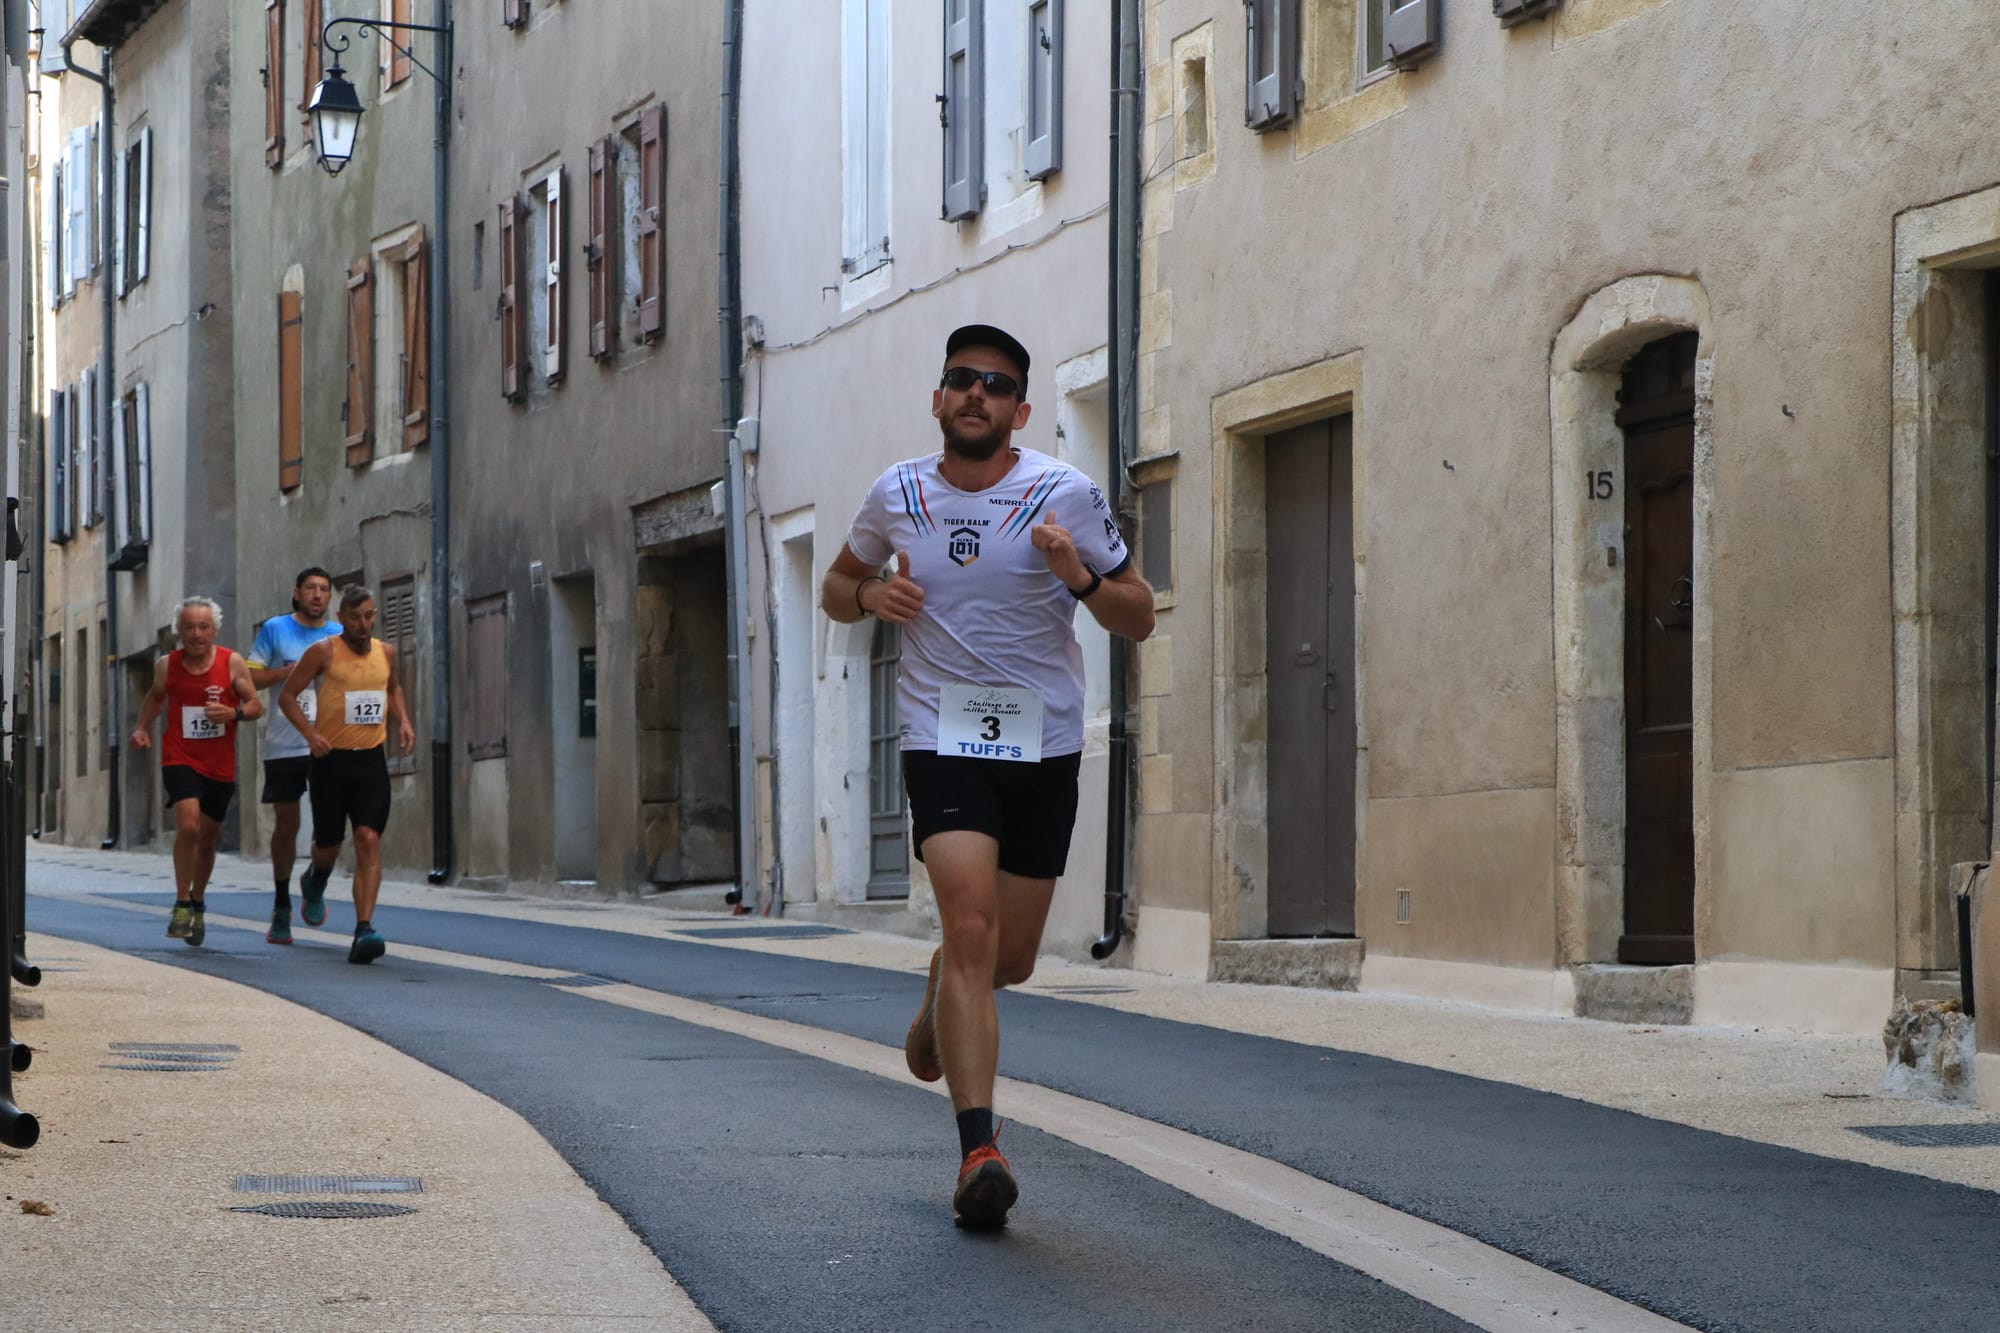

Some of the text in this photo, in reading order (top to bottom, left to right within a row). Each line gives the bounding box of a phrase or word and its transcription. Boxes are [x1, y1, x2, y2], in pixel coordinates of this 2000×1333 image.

[1586, 470, 1613, 499] 15
[989, 498, 1036, 507] MERRELL
[944, 518, 965, 526] TIGER
[354, 703, 381, 716] 127
[967, 700, 1002, 710] Challenge
[980, 716, 1001, 741] 3
[957, 742, 1022, 758] TUFF'S
